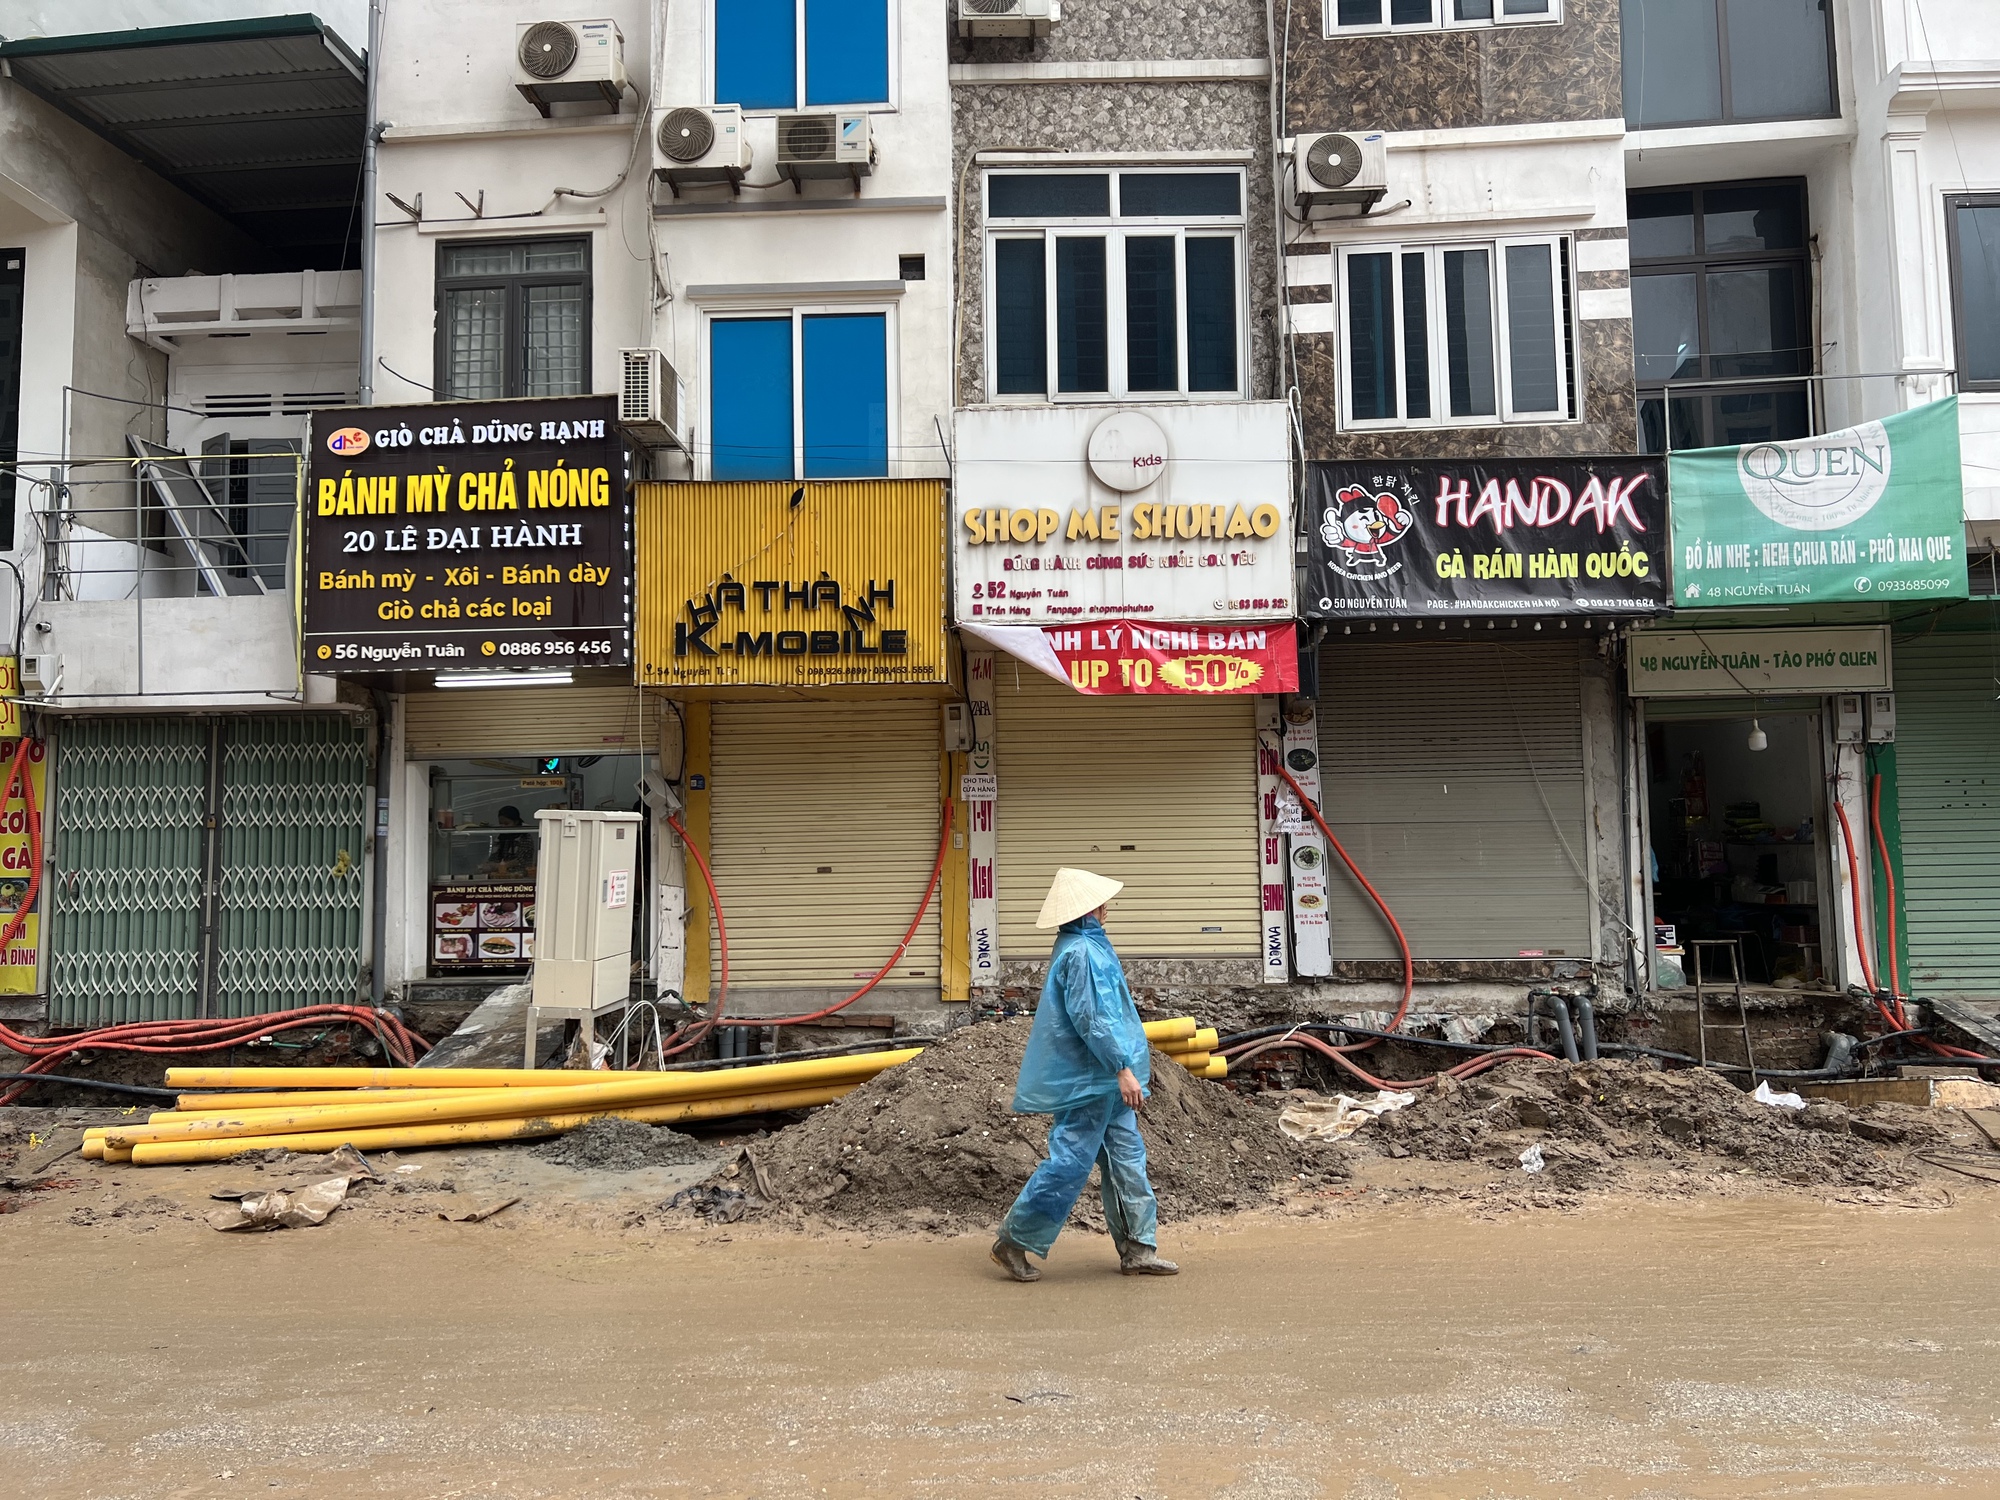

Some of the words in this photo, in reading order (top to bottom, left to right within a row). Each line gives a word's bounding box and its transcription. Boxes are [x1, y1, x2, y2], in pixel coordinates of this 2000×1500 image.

[374, 422, 414, 448] GIÒ
[419, 418, 465, 445] CHẢ
[471, 419, 533, 443] DŨNG
[540, 419, 605, 445] HẠNH
[1132, 454, 1163, 468] Kids
[1742, 443, 1886, 486] QUEN
[317, 470, 397, 516] BÁNH
[406, 466, 451, 512] MỲ
[458, 458, 519, 512] CHẢ
[527, 459, 610, 508] NÓNG
[1435, 472, 1649, 535] HANDAK
[343, 530, 375, 552] 20
[384, 525, 417, 551] LÊ
[426, 526, 480, 553] ĐẠI
[490, 519, 583, 548] HÀNH
[963, 506, 1060, 545] SHOP
[1066, 504, 1121, 542] ME
[1132, 502, 1281, 540] SHUHAO
[1199, 553, 1227, 567] CON
[1231, 550, 1258, 566] YÊU
[1435, 547, 1467, 579] GÀ
[1473, 543, 1522, 580] RÁN
[1529, 547, 1579, 579] HÀN
[1585, 540, 1649, 578] QUỐC
[1685, 537, 1703, 570] ĐỒ
[1705, 541, 1723, 569] ĂN
[1726, 543, 1750, 573] NHẸ
[1762, 542, 1790, 567] NEM
[1793, 540, 1828, 566] CHUA
[1831, 535, 1856, 564] RÁN
[1869, 533, 1895, 563] PHÔ
[1898, 538, 1924, 562] MAI
[1926, 535, 1952, 564] QUE
[319, 568, 375, 590] Bánh
[381, 568, 416, 592] mỳ
[444, 566, 479, 586] Xôi
[502, 564, 561, 585] Bánh
[568, 562, 611, 586] dày
[1327, 561, 1346, 577] KOREA
[1346, 573, 1374, 581] CHICKEN
[1374, 572, 1388, 581] AND
[1387, 562, 1402, 574] BEER
[987, 581, 1006, 599] 52
[1707, 586, 1721, 598] 48
[1724, 583, 1774, 597] NGUYỄN
[1777, 582, 1811, 596] TUÂN
[1878, 579, 1950, 592] 0933685099
[377, 599, 414, 621] Giò
[420, 597, 460, 618] chả
[465, 598, 505, 617] các
[512, 596, 552, 621] loại
[1334, 599, 1345, 609] 50
[1347, 595, 1382, 609] NGUYỄN
[1384, 597, 1408, 609] TUÂN
[1427, 600, 1449, 609] PAGE
[1454, 600, 1531, 609] #HANDAKCHICKEN
[1532, 598, 1545, 608] HÀ
[1545, 598, 1560, 609] NỘI
[1636, 598, 1655, 608] 684
[674, 620, 908, 657] K-MOBILE
[1091, 622, 1121, 650] LÝ
[1132, 628, 1199, 650] NGHỈ
[1208, 630, 1266, 650] BÁN
[335, 643, 358, 659] 56
[361, 642, 421, 662] Nguyễn
[425, 642, 465, 658] Tuân
[499, 641, 541, 656] 0886
[544, 640, 575, 655] 956
[578, 640, 611, 654] 456
[1640, 656, 1658, 672] 48
[1661, 650, 1718, 671] NGUYỄN
[1721, 651, 1760, 669] TUÂN
[1773, 650, 1803, 668] TÀO
[1806, 648, 1836, 667] PHỚ
[1838, 650, 1877, 667] QUEN
[657, 667, 670, 676] 54
[1071, 659, 1110, 689] UP
[1118, 658, 1153, 687] TO
[1184, 659, 1249, 687] 50%
[977, 785, 996, 793] HÀNG
[978, 776, 995, 784] THUÊ
[1263, 884, 1285, 912] SINH
[11, 946, 36, 966] ĐÌNH
